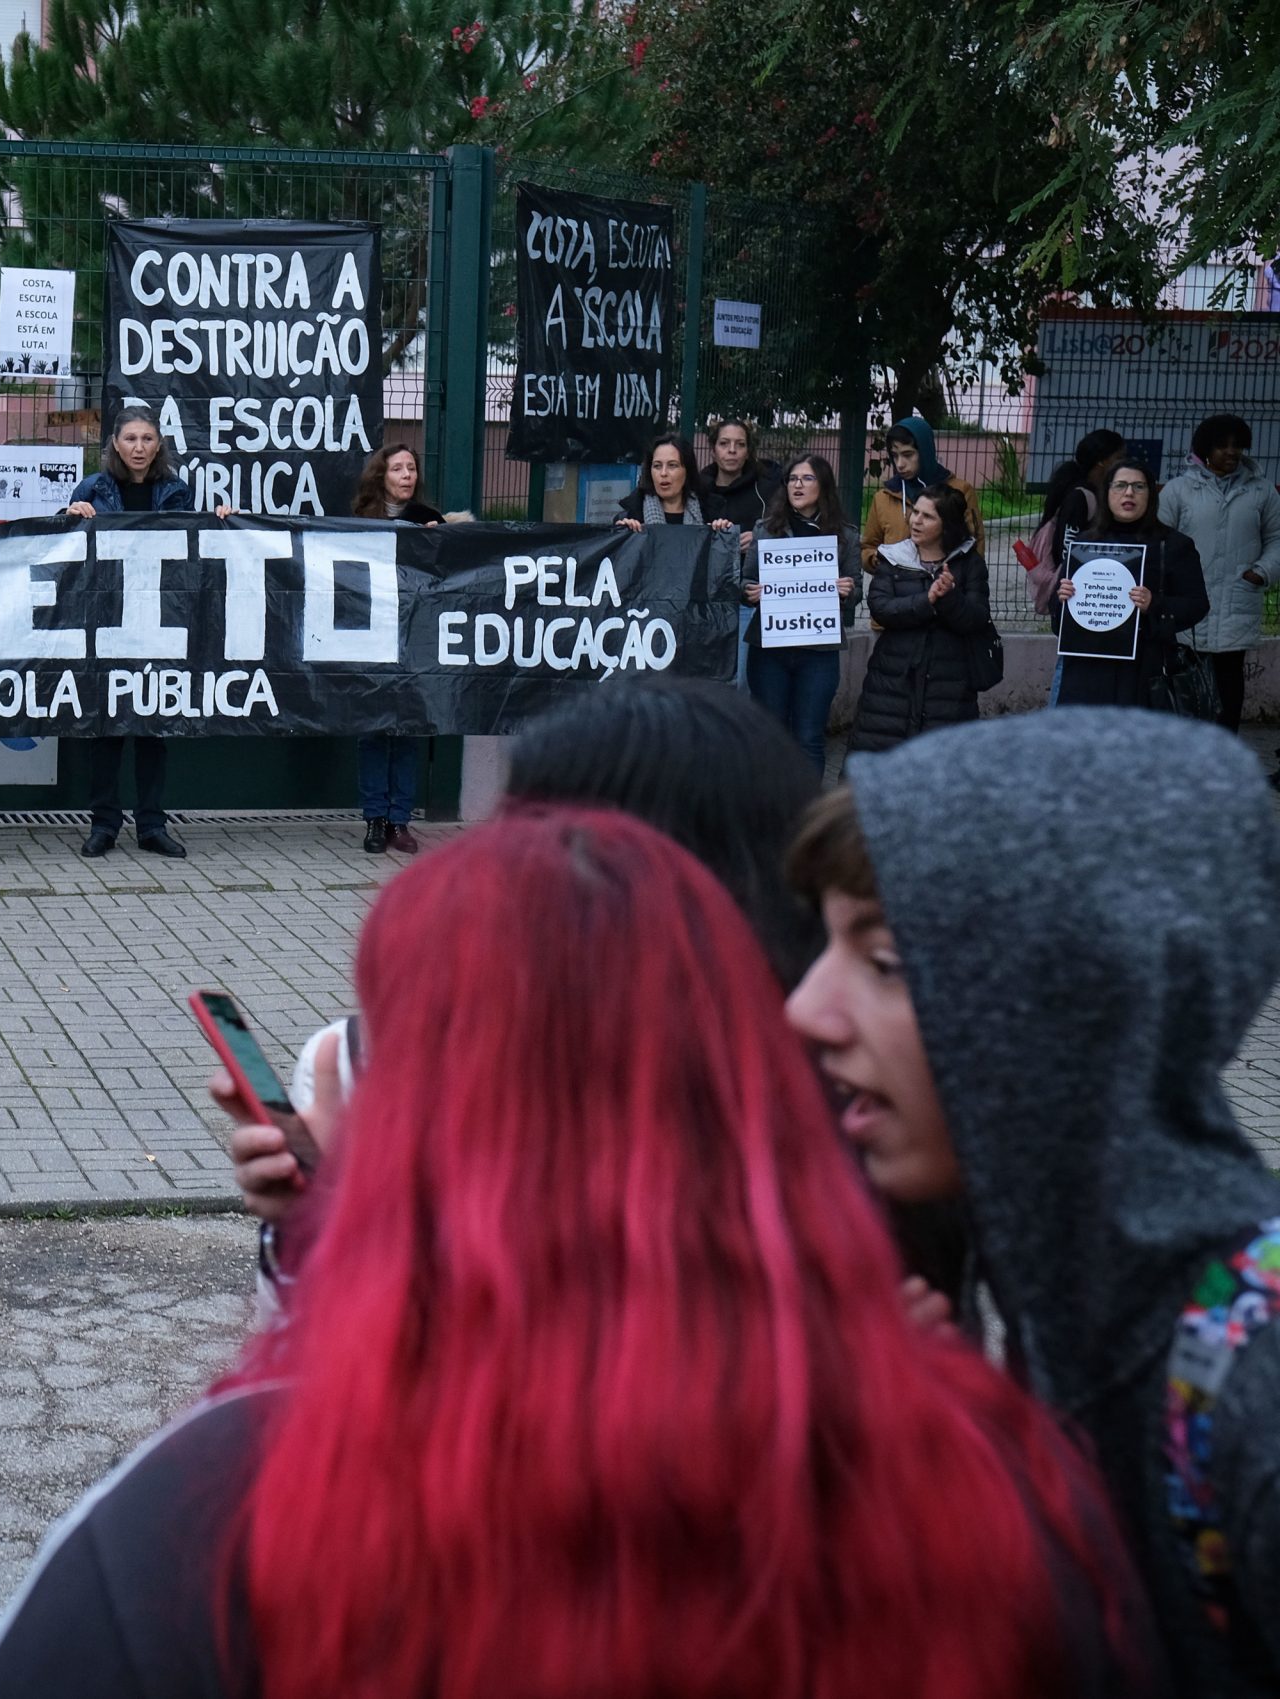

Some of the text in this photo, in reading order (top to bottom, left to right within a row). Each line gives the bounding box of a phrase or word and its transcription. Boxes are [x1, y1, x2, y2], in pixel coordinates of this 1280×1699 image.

[526, 210, 671, 284] COSTA, ESCUTA!
[22, 278, 54, 289] COSTA,
[130, 250, 365, 310] CONTRA A
[19, 294, 56, 304] ESCUTA!
[25, 310, 58, 320] ESCOLA
[545, 283, 662, 354] A ESCOLA
[18, 324, 55, 334] ESTÁ EM
[22, 340, 48, 350] LUTA!
[120, 312, 370, 388] DESTRUIÇÃO
[1230, 339, 1280, 360] 202
[524, 368, 661, 424] ESTÁ EM LUTA!
[121, 394, 373, 455] A ESCOLA
[764, 550, 834, 566] Respeito
[504, 556, 621, 610] PELA
[764, 582, 835, 597] Dignidade
[1085, 592, 1118, 600] profissão
[764, 613, 836, 634] Justiça
[1088, 618, 1110, 626] digna!
[438, 608, 677, 682] EDUCAÇÃO
[108, 662, 279, 718] PÚBLICA
